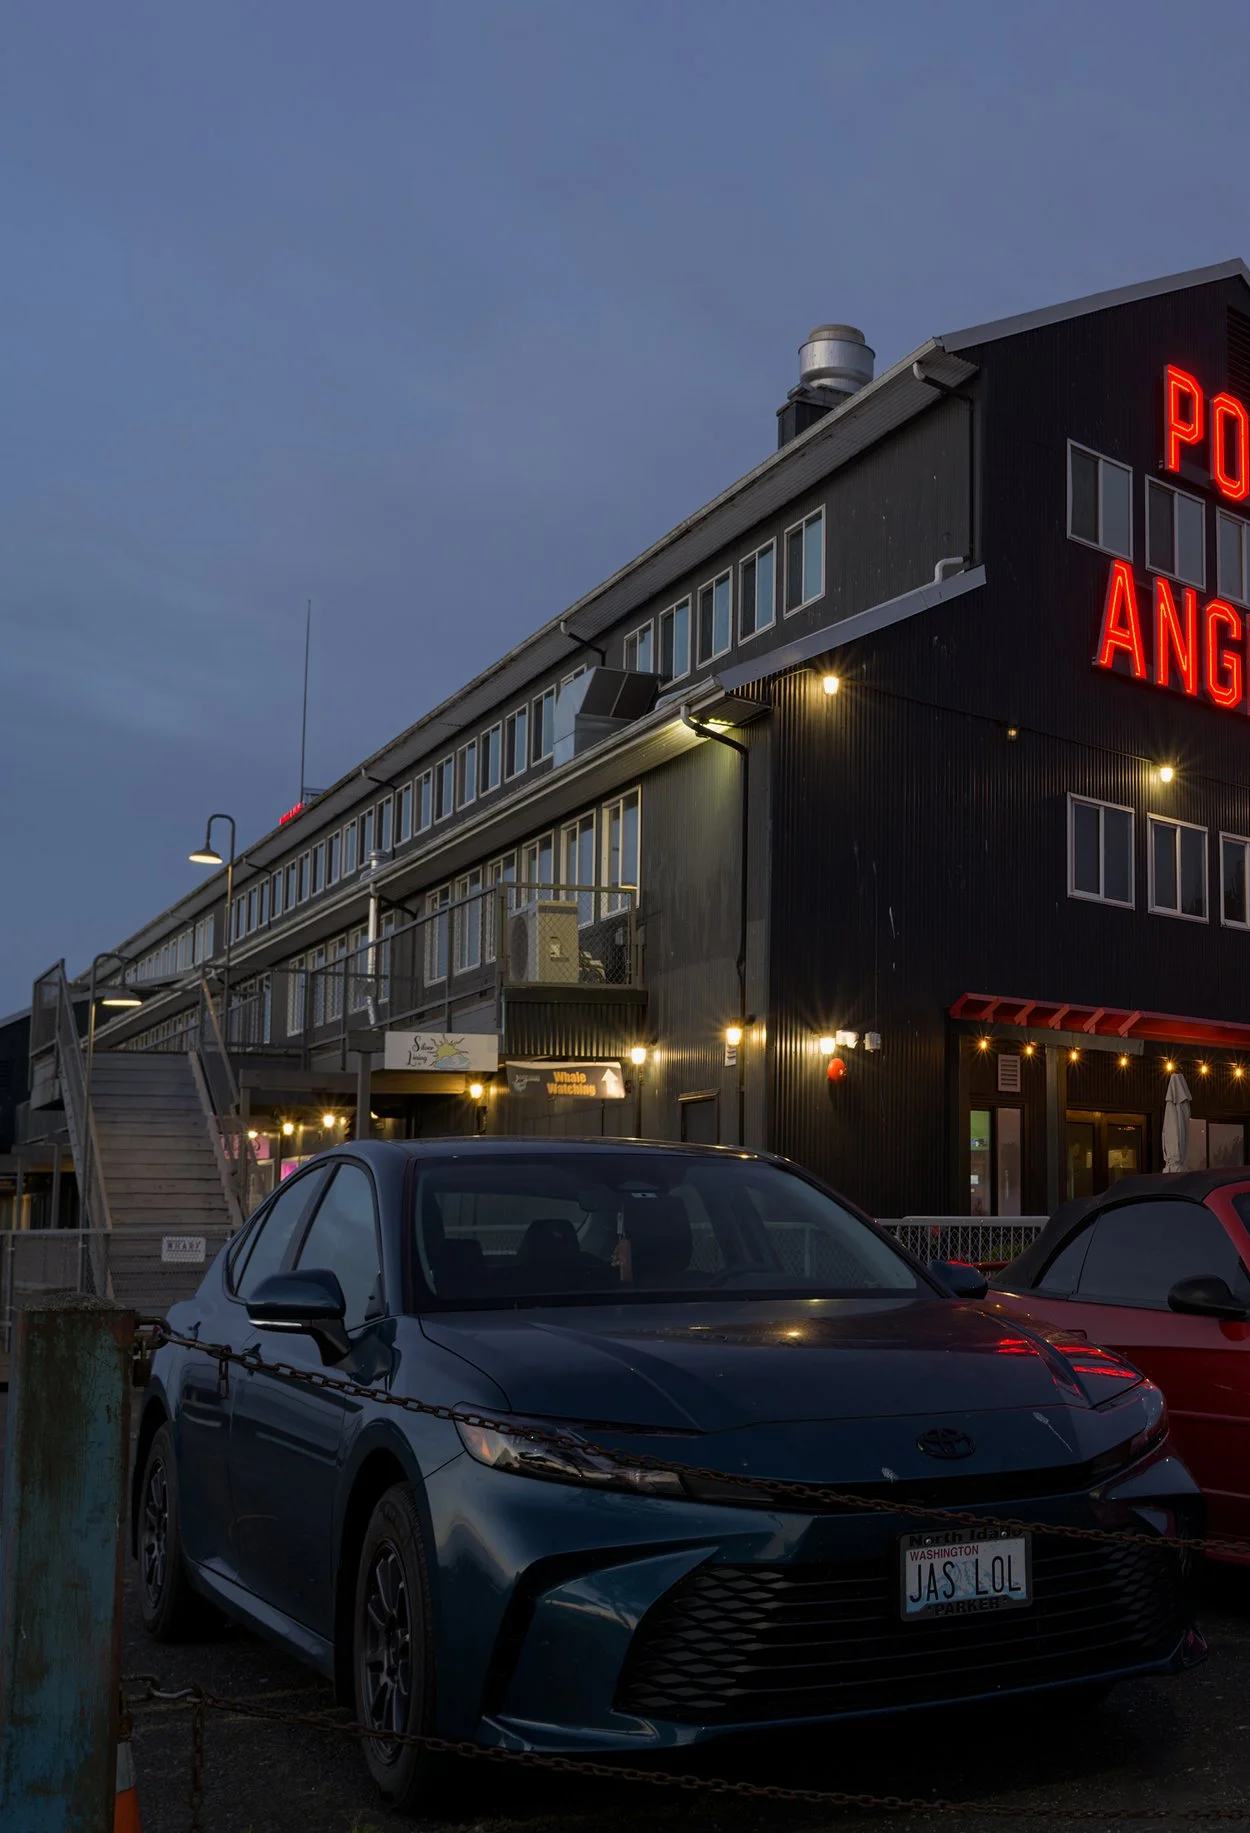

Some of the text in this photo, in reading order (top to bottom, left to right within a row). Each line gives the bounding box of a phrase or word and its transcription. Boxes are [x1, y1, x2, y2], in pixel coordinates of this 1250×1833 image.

[553, 1071, 587, 1083] Whale
[546, 1083, 597, 1096] Watching
[910, 1545, 979, 1562] WASHINGTON
[910, 1555, 1022, 1603] JAS LOL
